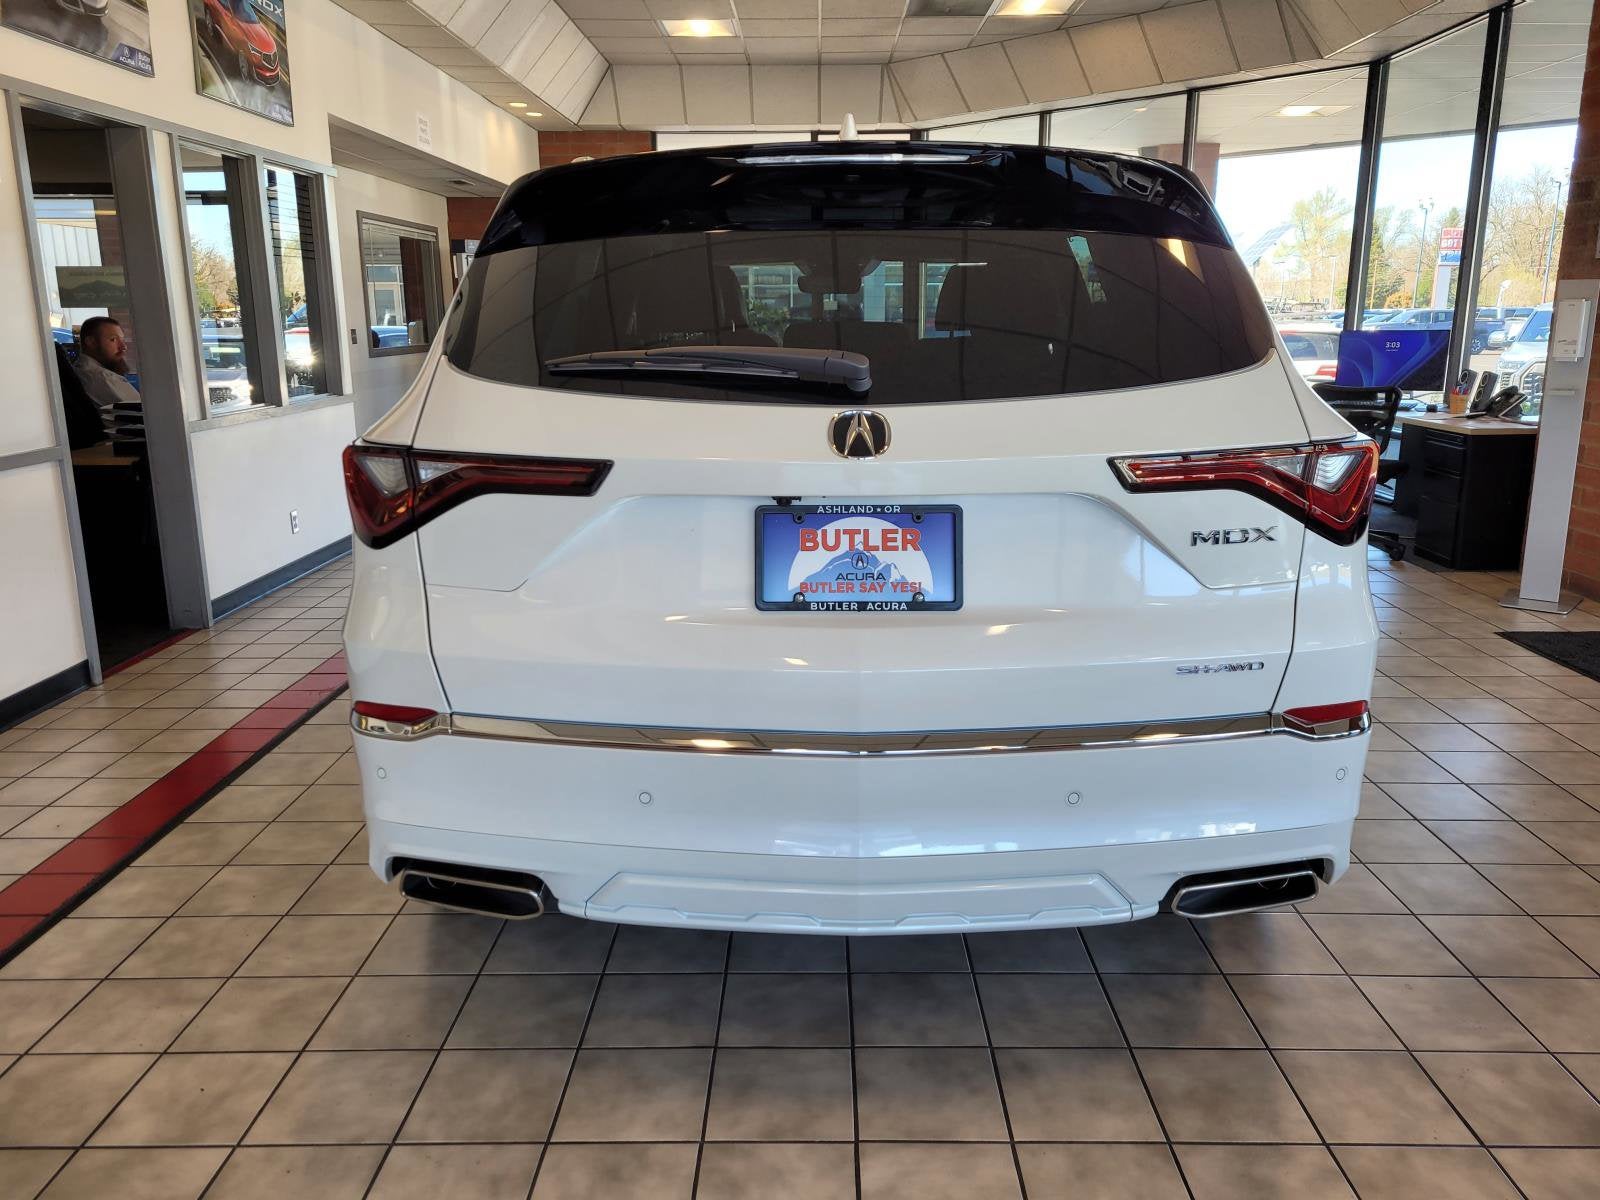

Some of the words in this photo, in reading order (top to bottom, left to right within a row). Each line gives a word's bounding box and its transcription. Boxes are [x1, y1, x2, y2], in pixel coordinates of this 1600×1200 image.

[817, 505, 874, 514] ASHLAND
[884, 505, 901, 514] OR
[800, 528, 922, 552] BUTLER
[1190, 526, 1278, 547] MDX
[835, 572, 886, 581] ACURA
[800, 581, 855, 594] BUTLER
[859, 581, 886, 593] SAY
[890, 581, 922, 594] YES!
[810, 602, 858, 611] BUTLER
[866, 602, 908, 611] ACURA
